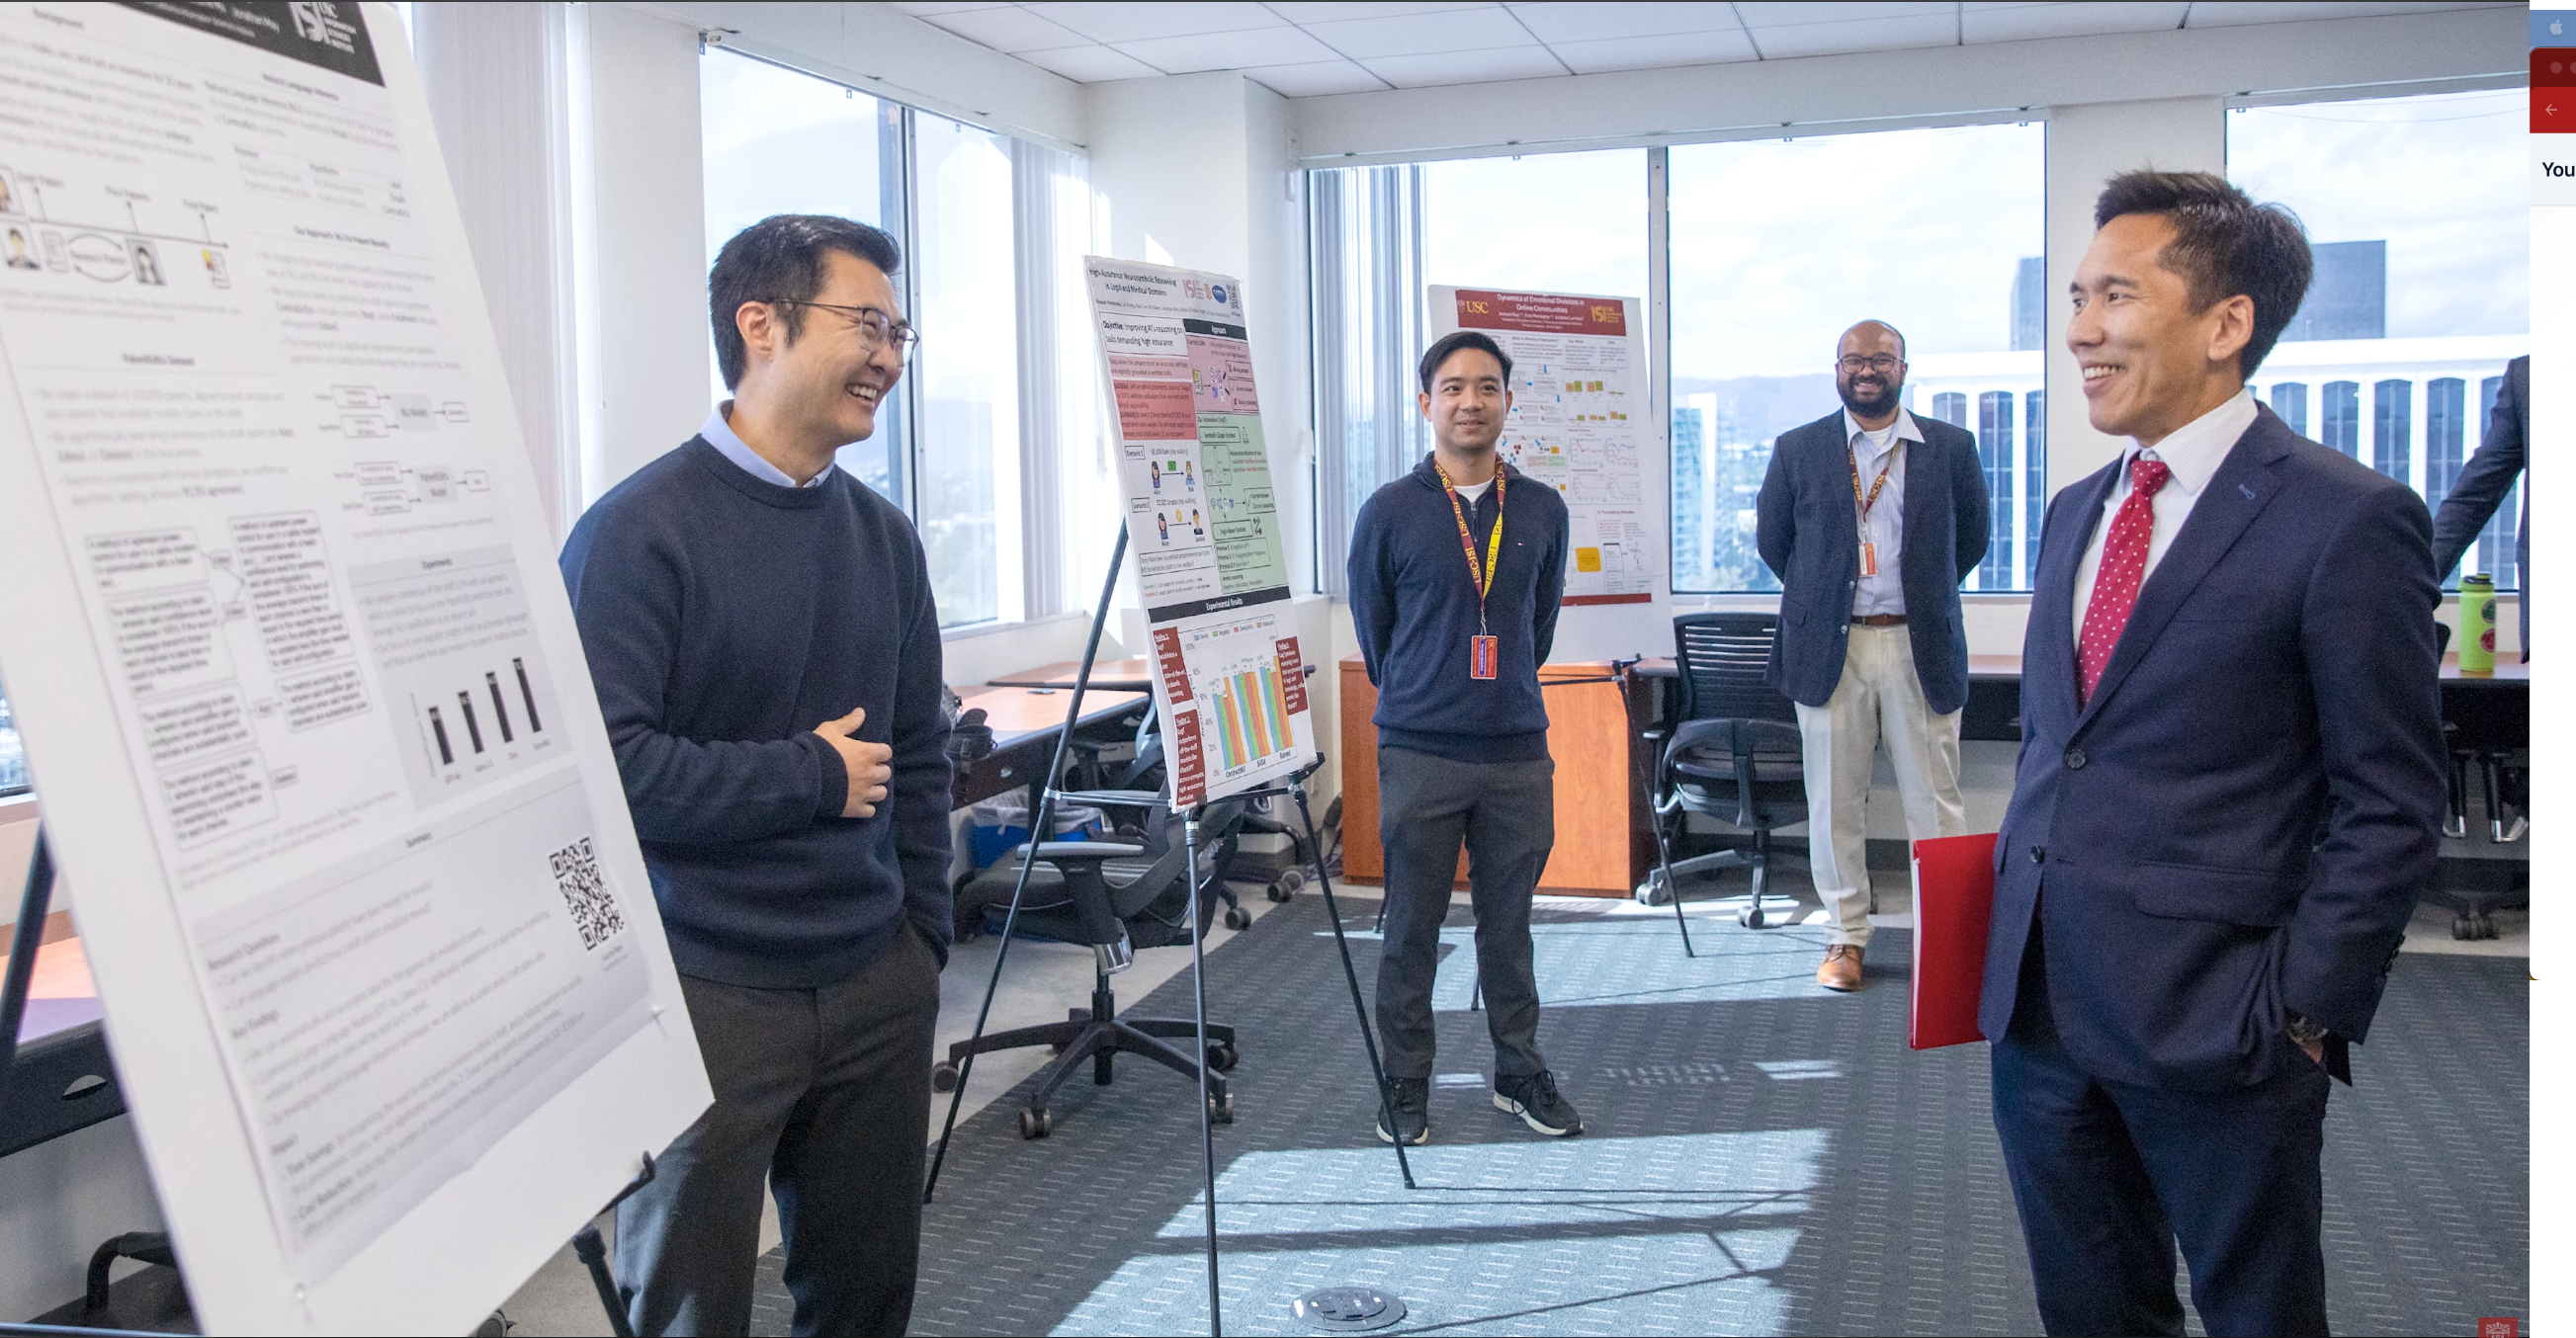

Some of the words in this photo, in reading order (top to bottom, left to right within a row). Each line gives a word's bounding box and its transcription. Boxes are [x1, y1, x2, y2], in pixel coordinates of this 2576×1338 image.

[1465, 300, 1490, 314] USC
[1453, 501, 1470, 537] USC-ISI
[1465, 546, 1482, 583] USC-ISI
